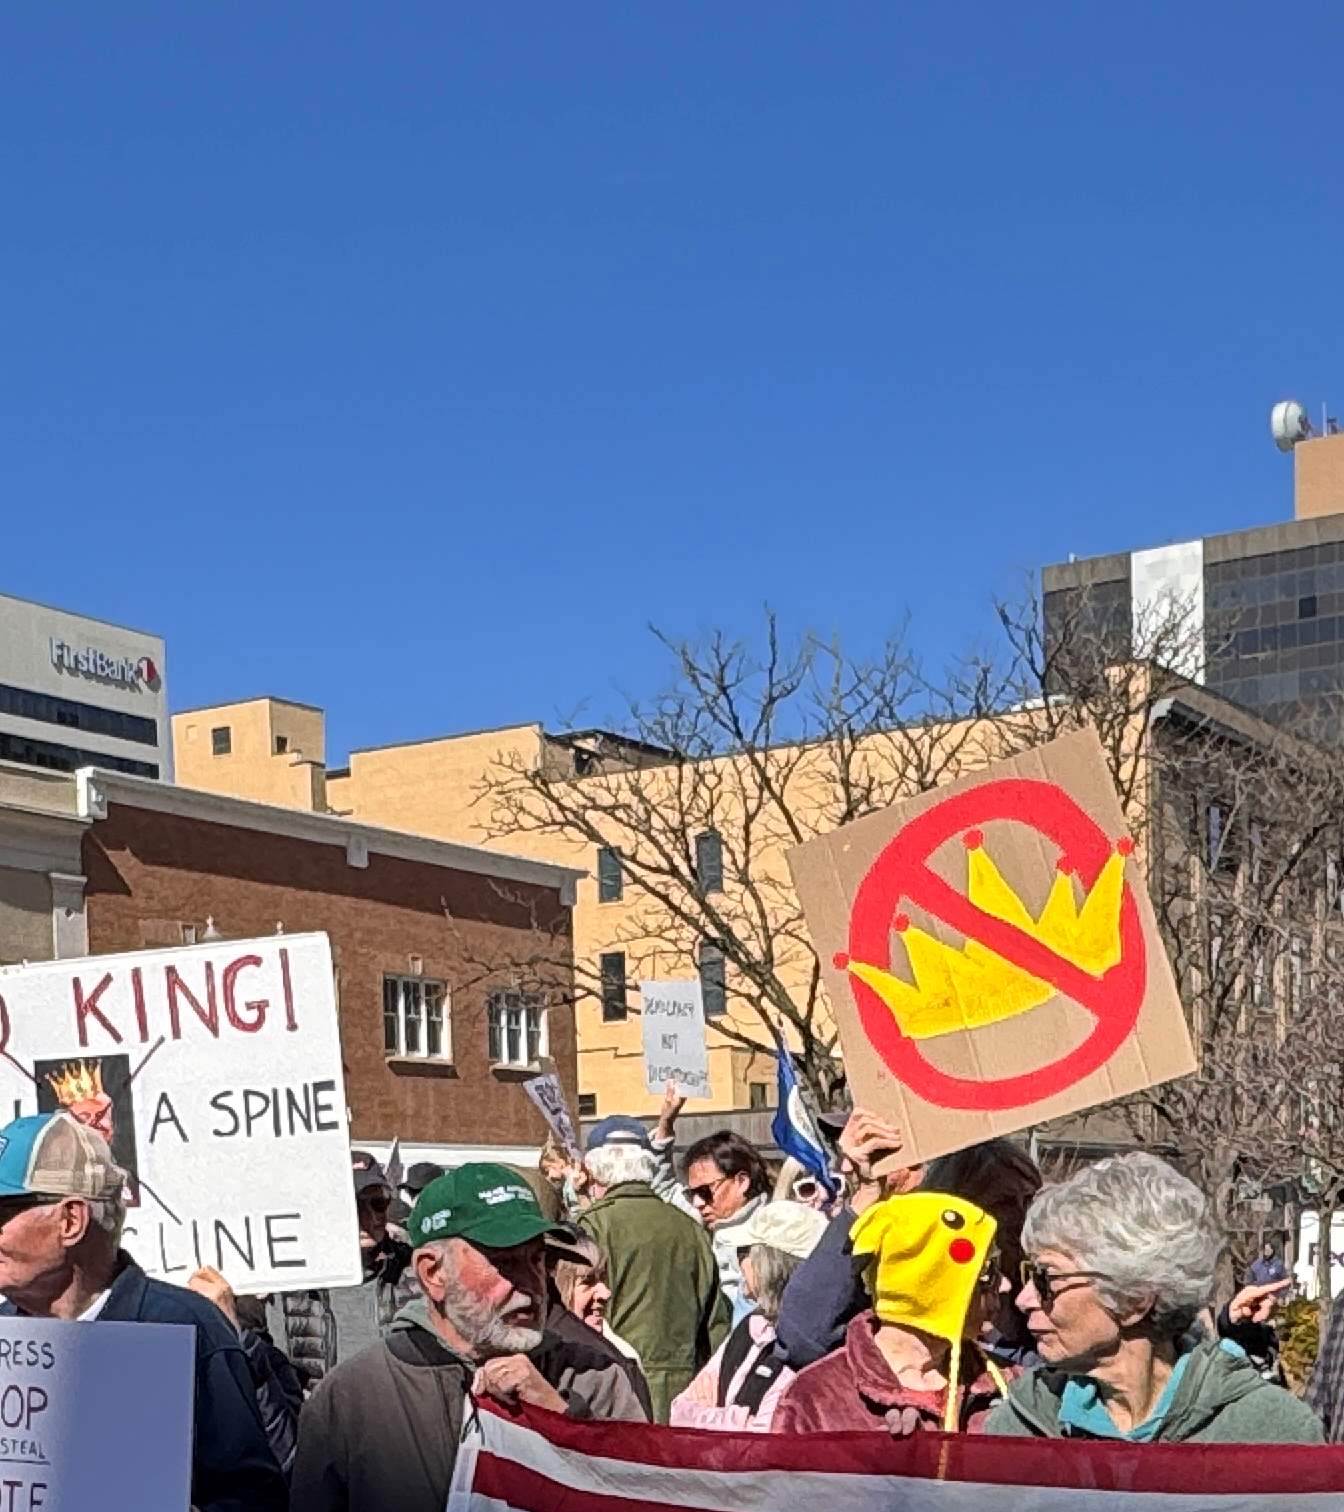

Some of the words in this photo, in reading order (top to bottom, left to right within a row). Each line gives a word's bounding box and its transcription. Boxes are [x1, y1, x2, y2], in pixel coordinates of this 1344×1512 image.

[71, 947, 299, 1049] KING!
[149, 1092, 189, 1145] A
[209, 1080, 341, 1139] SPINE
[124, 1212, 308, 1275] LINE
[0, 1437, 46, 1461] STEAL
